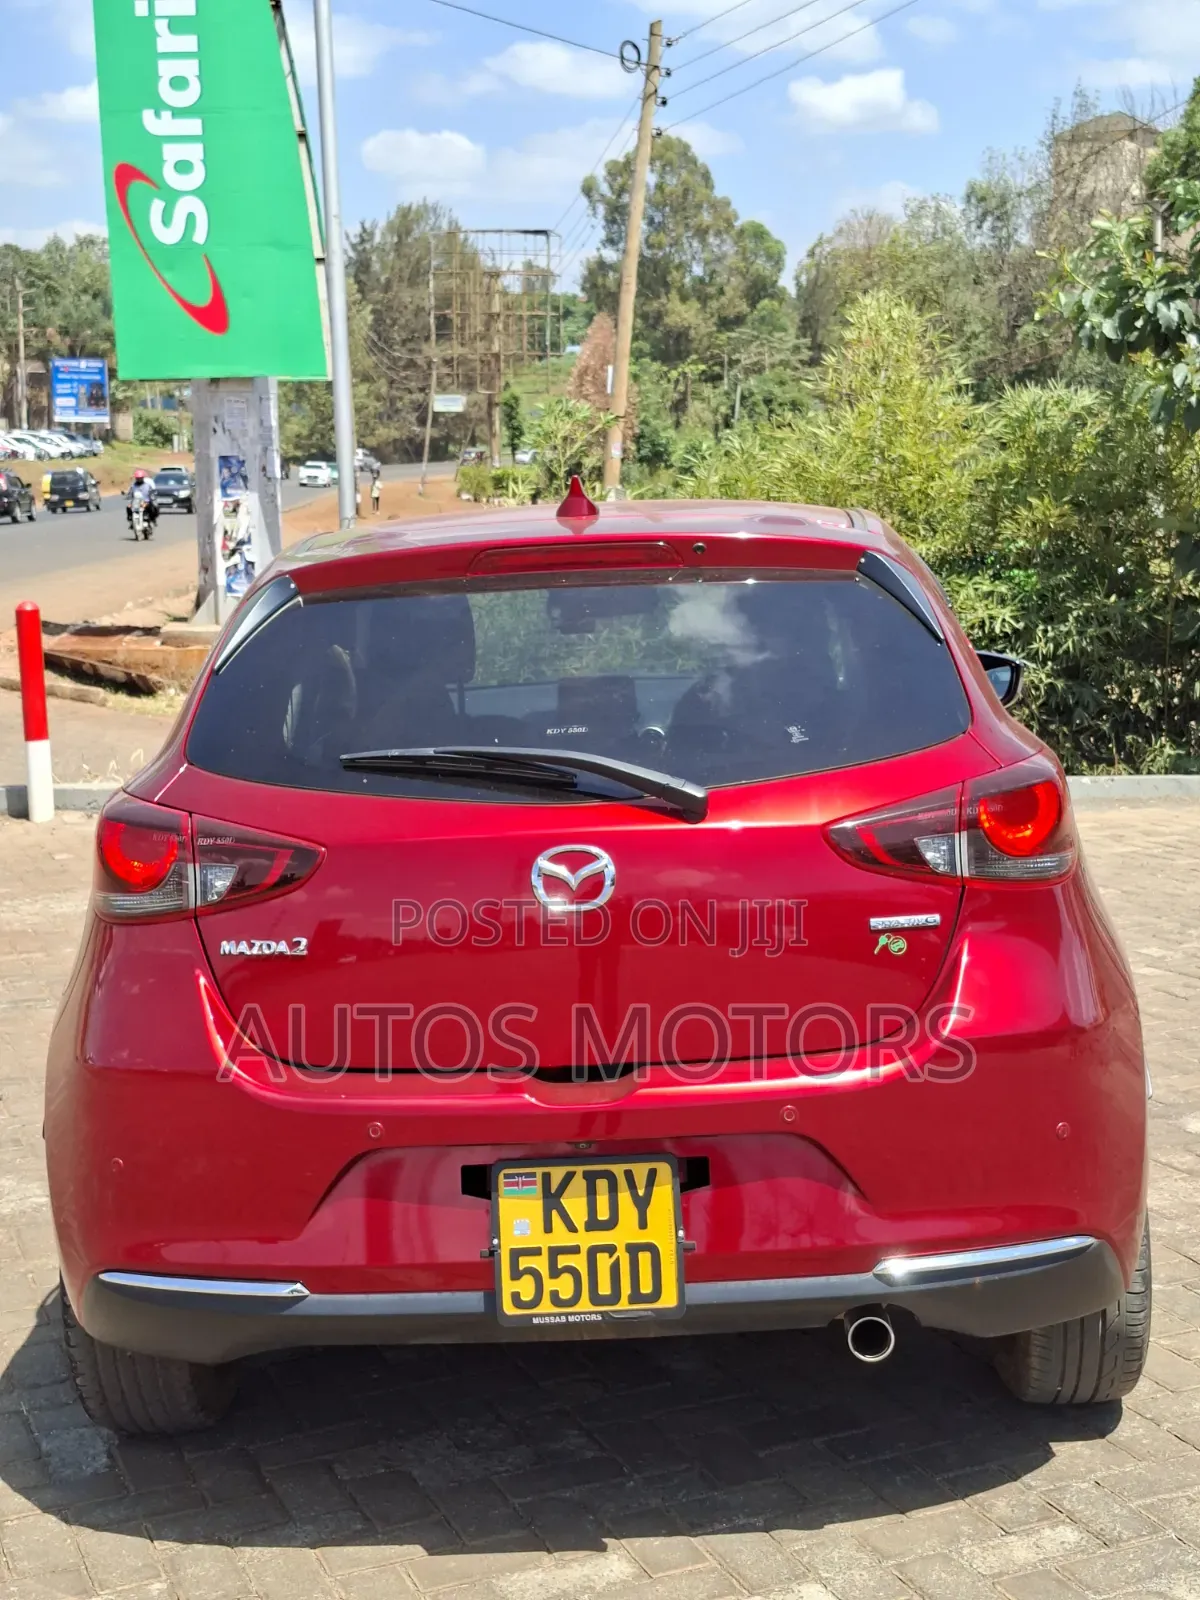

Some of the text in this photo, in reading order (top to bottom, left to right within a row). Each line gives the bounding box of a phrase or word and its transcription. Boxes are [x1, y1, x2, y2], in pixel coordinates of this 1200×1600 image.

[134, 0, 208, 245] Safari
[541, 1167, 658, 1234] KDY
[508, 1241, 663, 1310] 550D
[532, 1313, 603, 1324] MUSSAB MOTORS
